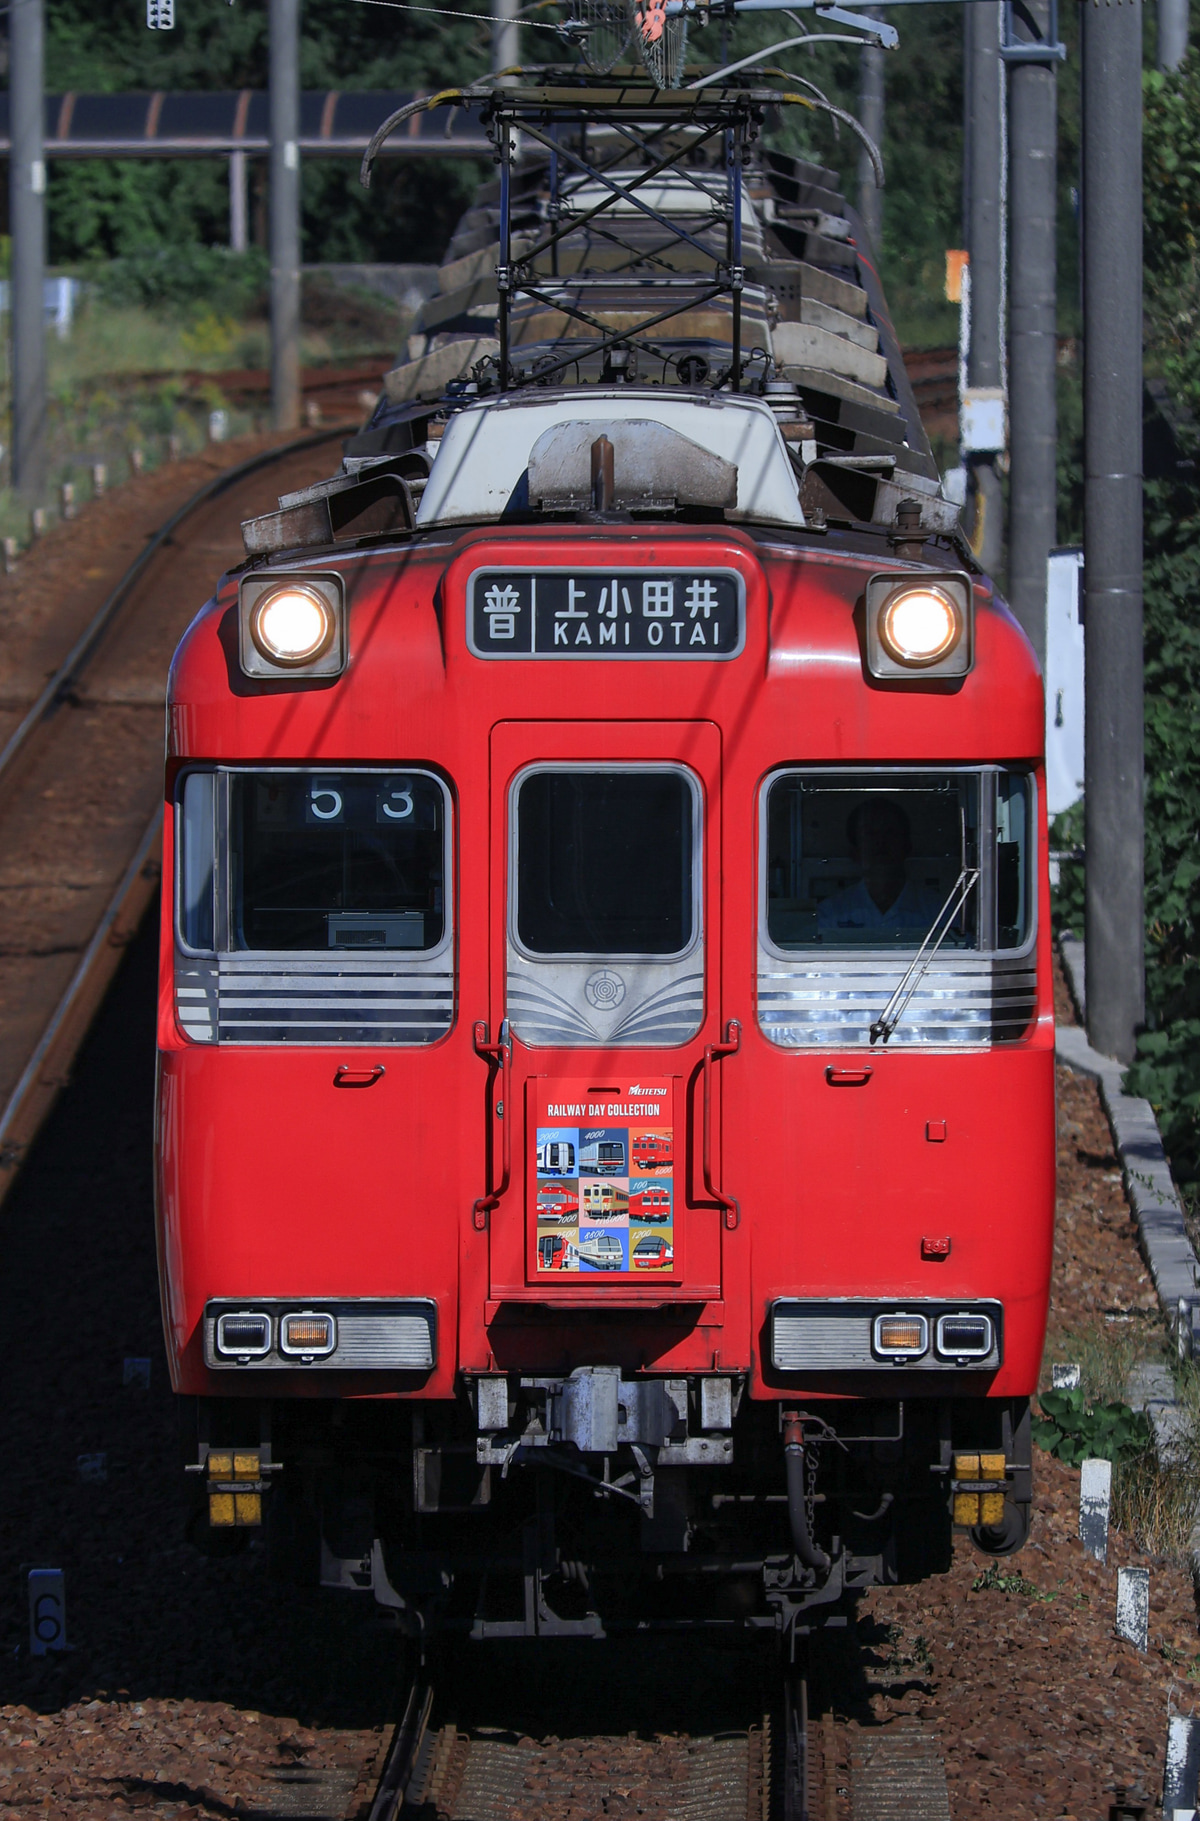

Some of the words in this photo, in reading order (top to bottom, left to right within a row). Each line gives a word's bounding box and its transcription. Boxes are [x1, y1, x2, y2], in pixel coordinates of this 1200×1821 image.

[554, 579, 719, 618] 上小田井
[484, 584, 521, 639] 普
[554, 621, 630, 645] KAMI
[647, 621, 719, 645] OTAI
[628, 1084, 667, 1096] MEITETSU
[547, 1103, 587, 1117] RAILWAY
[588, 1103, 605, 1116] DAY
[607, 1103, 660, 1116] COLLECTION
[584, 1130, 605, 1140] 4000
[654, 1166, 673, 1176] 6000
[632, 1180, 648, 1190] 100
[583, 1229, 605, 1240] 8800
[632, 1229, 652, 1240] 1200
[34, 1594, 60, 1643] 6
